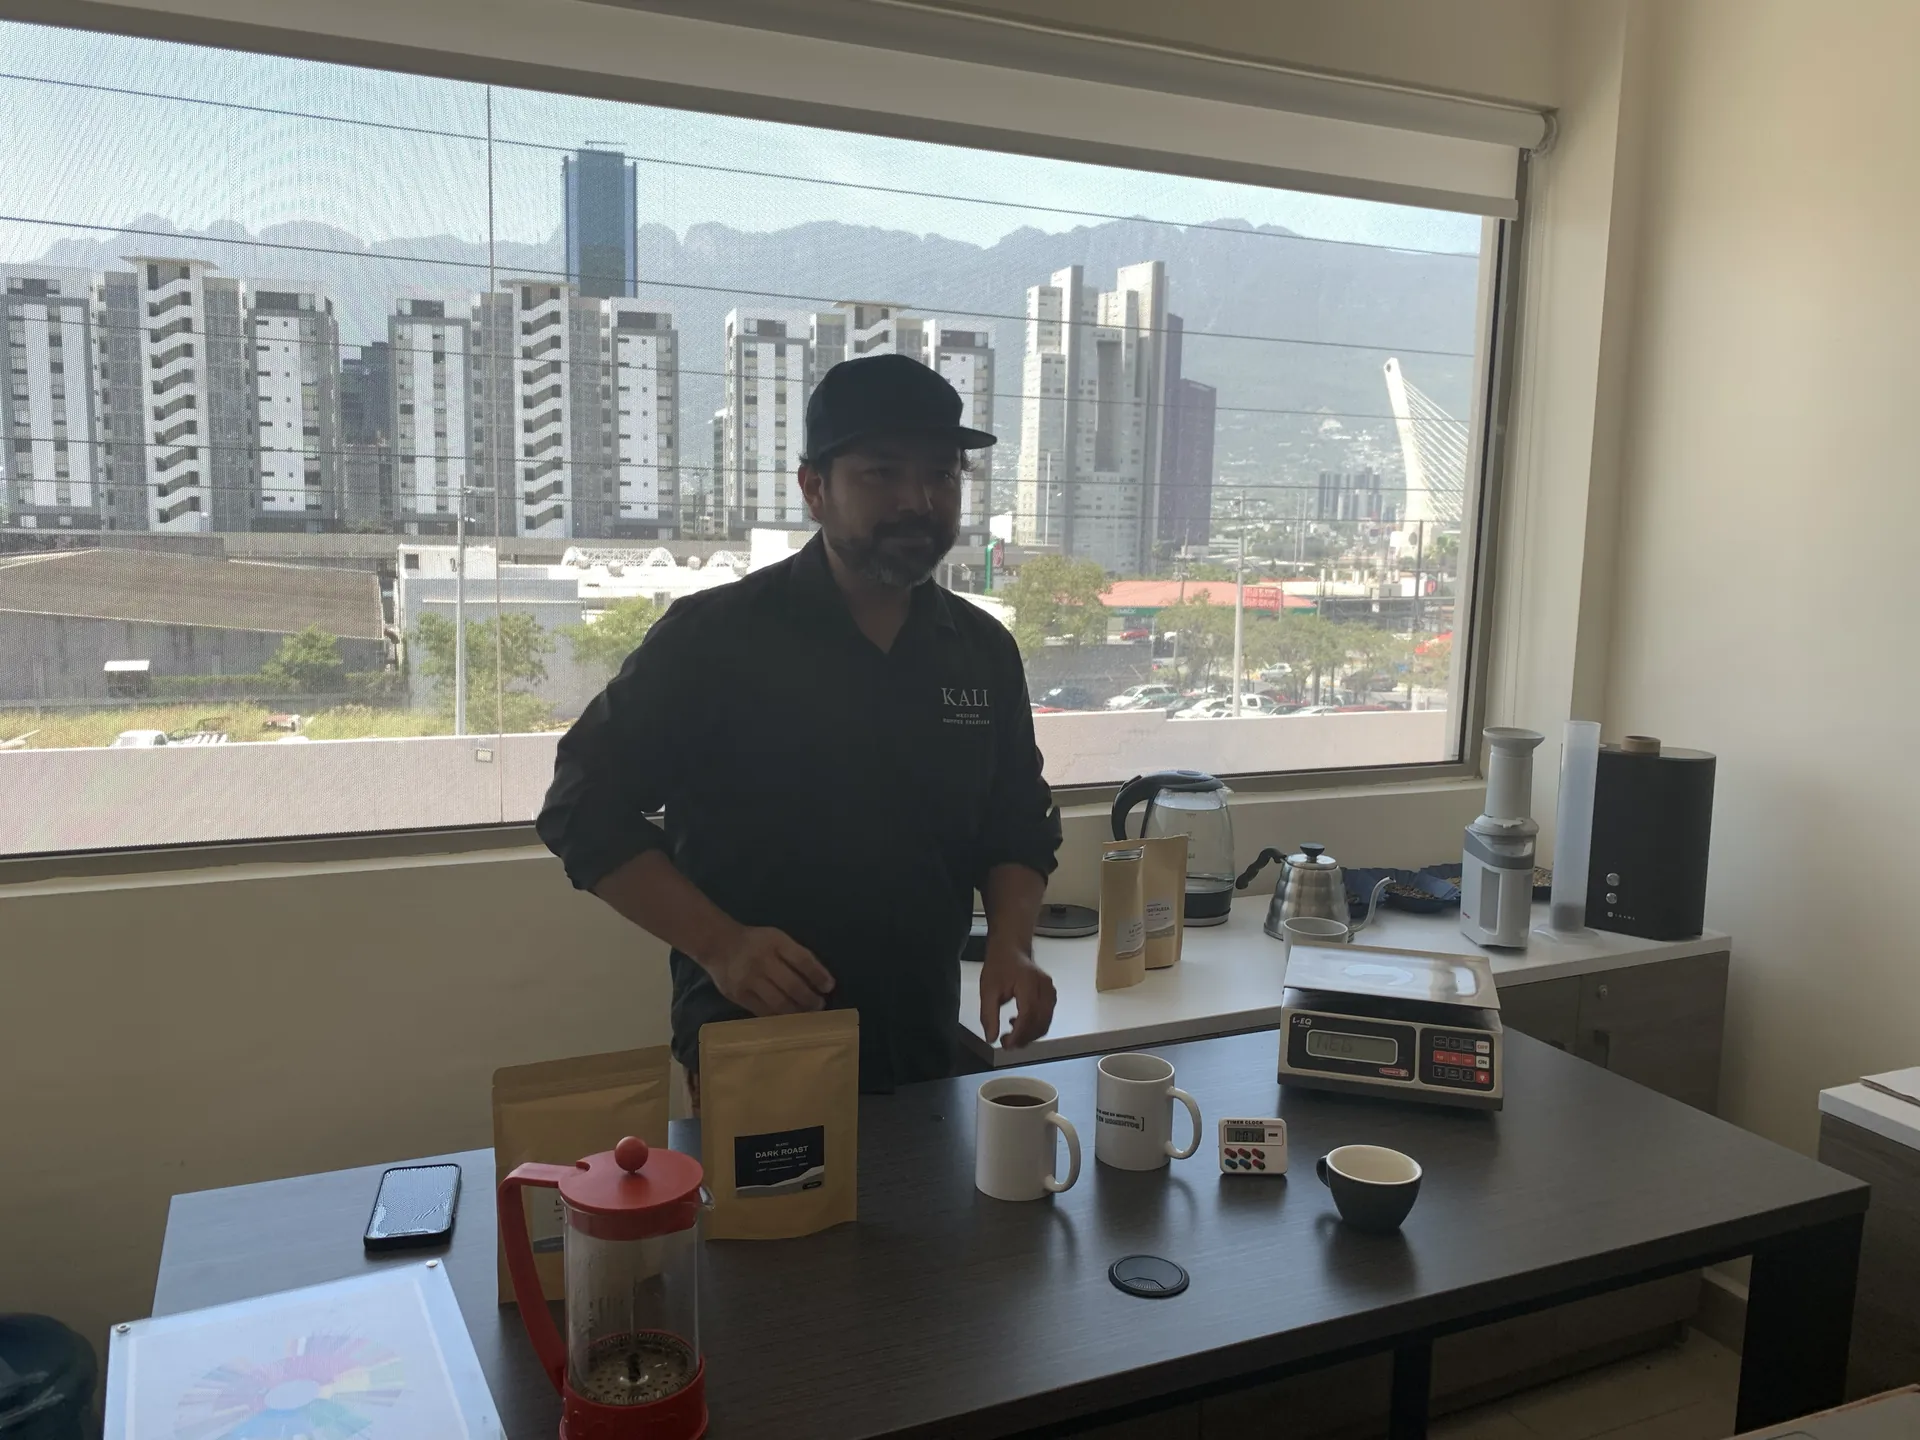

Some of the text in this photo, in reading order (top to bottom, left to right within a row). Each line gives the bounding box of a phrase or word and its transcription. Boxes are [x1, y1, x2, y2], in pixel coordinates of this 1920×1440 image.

[940, 687, 990, 707] KALI
[755, 1145, 809, 1159] DARK ROAST
